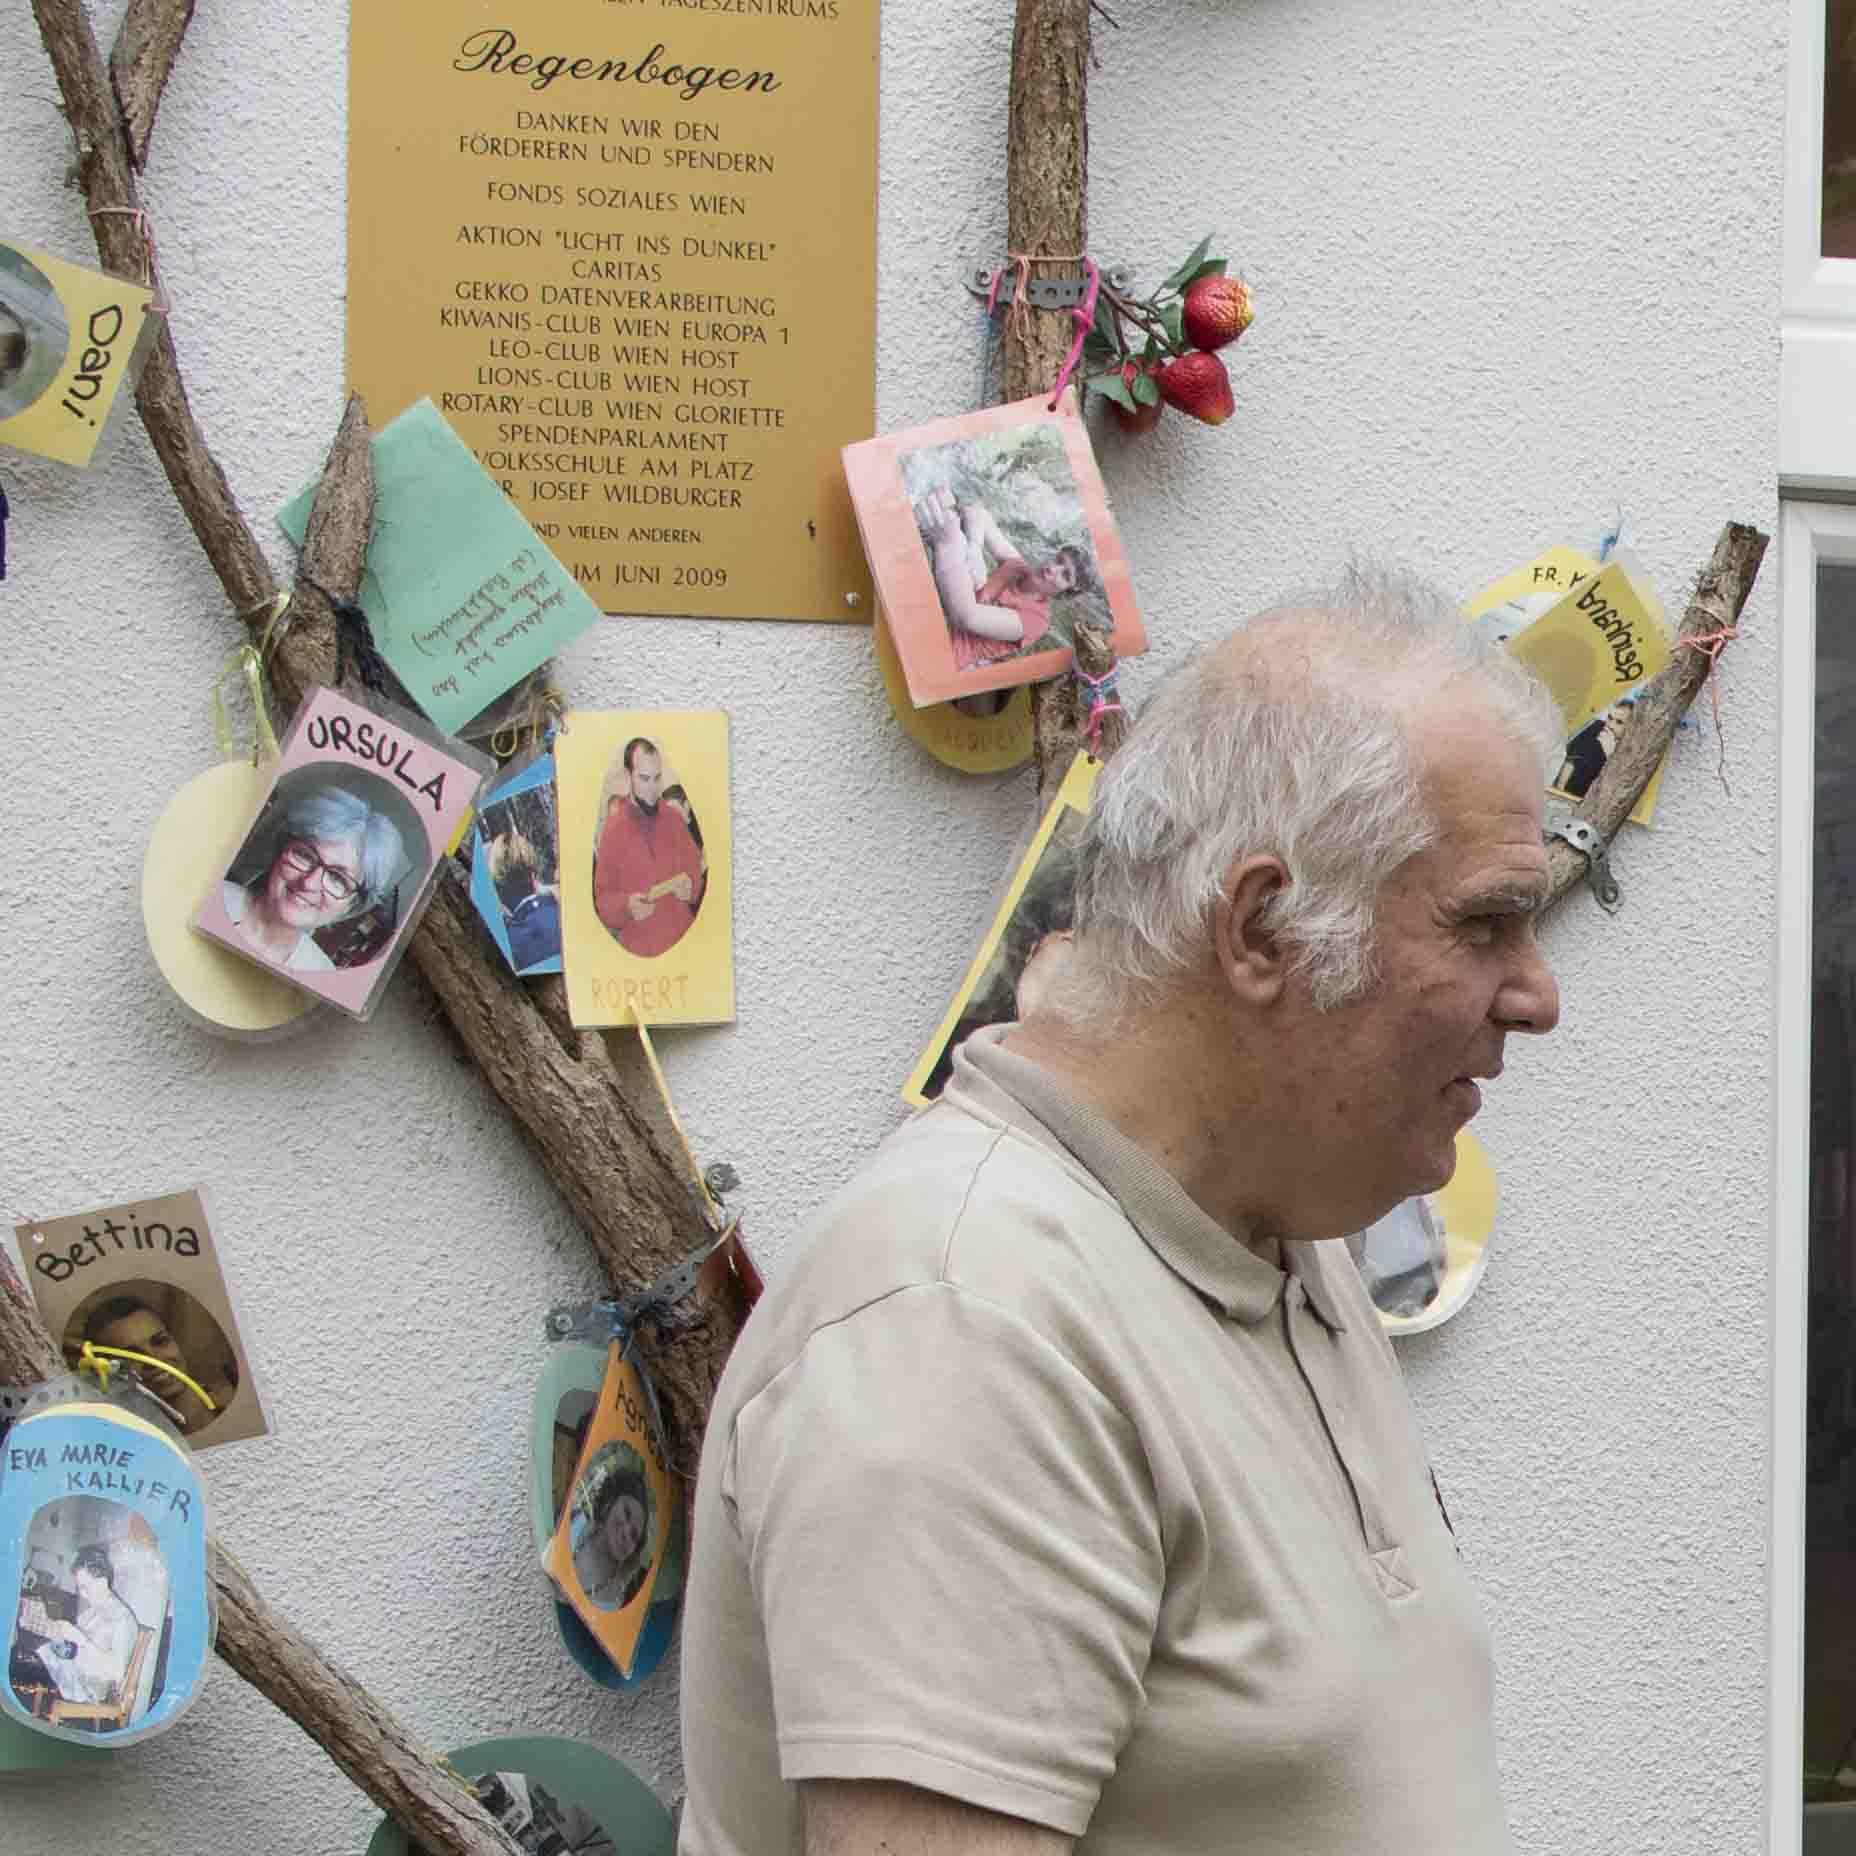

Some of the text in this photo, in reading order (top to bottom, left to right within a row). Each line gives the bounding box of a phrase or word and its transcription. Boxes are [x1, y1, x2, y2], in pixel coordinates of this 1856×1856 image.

[452, 29, 783, 101] Regenbogen
[517, 111, 720, 142] DANKEN WIR DEN
[459, 132, 775, 173] FÖRDERERN UND SPENDERN
[487, 181, 746, 216] FONDS SOZIALES WIEN
[456, 225, 542, 247] AKTION
[636, 235, 671, 256] INS
[571, 259, 662, 282] CARITAS
[455, 281, 776, 317] GEKKO DATENVERARBEITUNG
[440, 308, 791, 345] KIWANIS-CLUB WIEN EUROPA 1
[61, 303, 122, 427] Dani
[489, 339, 740, 369] LEO-CLUB WIEN HOST
[477, 366, 752, 399] LIONS-CLUB WIEN HOST
[441, 393, 785, 428] ROTARY-CLUB WIEN GLORIETTE
[498, 423, 729, 452] SPENDENPARLAMENT
[640, 459, 679, 478] AM
[691, 460, 754, 482] PLATZ
[532, 480, 591, 502] JOSEF
[603, 483, 742, 508] WILDBURGER
[568, 524, 619, 541] VIELEN
[573, 564, 727, 587] IM JUNI 2009
[307, 715, 447, 812] URSULA
[591, 974, 690, 1011] ROBERT
[35, 1214, 200, 1283] Bettina
[10, 1444, 135, 1472] EVA MARIE
